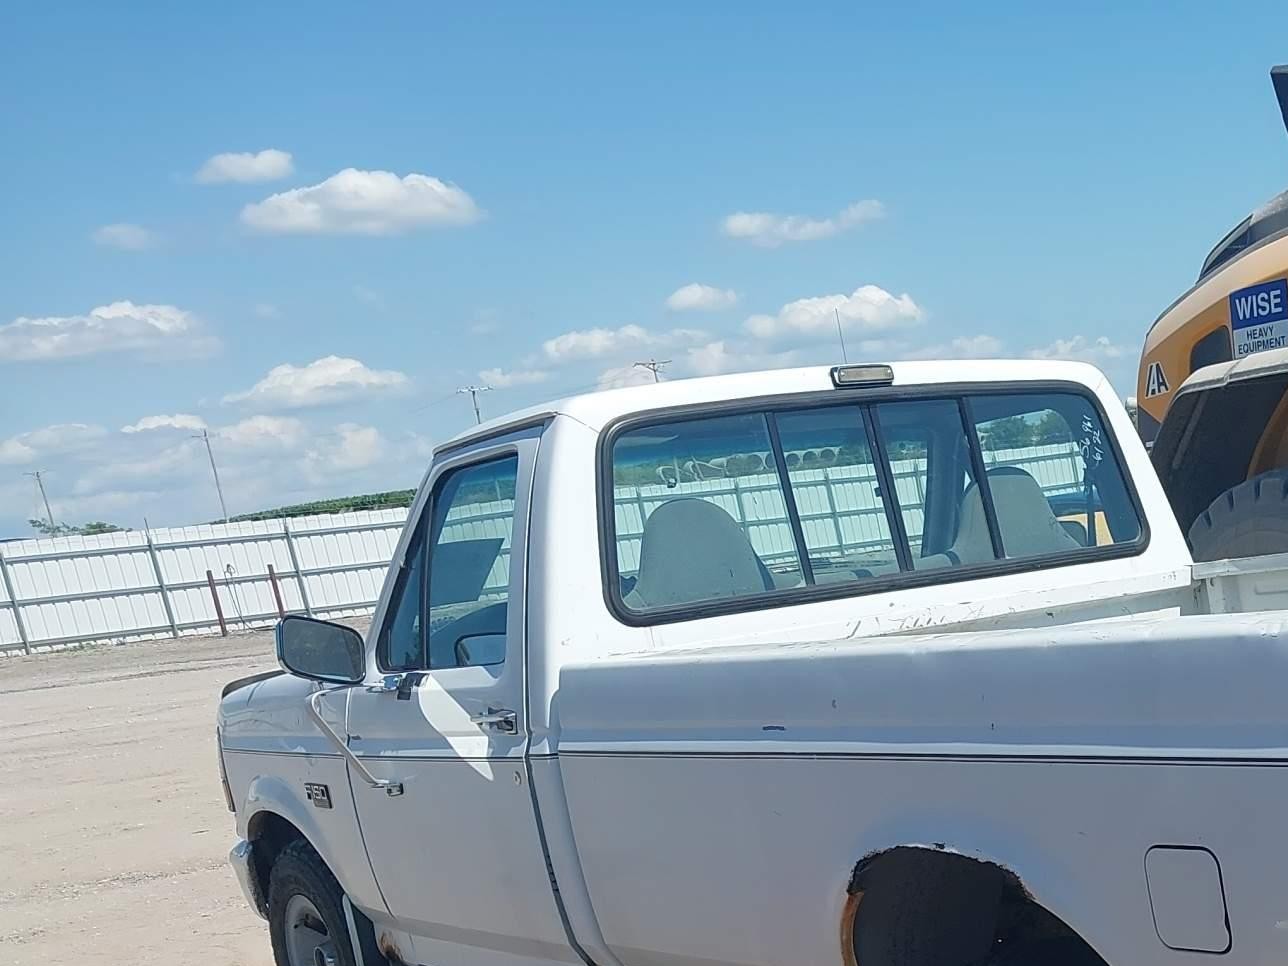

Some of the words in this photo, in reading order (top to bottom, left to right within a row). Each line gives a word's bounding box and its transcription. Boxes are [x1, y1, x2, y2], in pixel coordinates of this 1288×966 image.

[1235, 289, 1283, 320] WISE
[1246, 325, 1274, 342] HEAVY
[1238, 335, 1286, 355] EQUIPMENT
